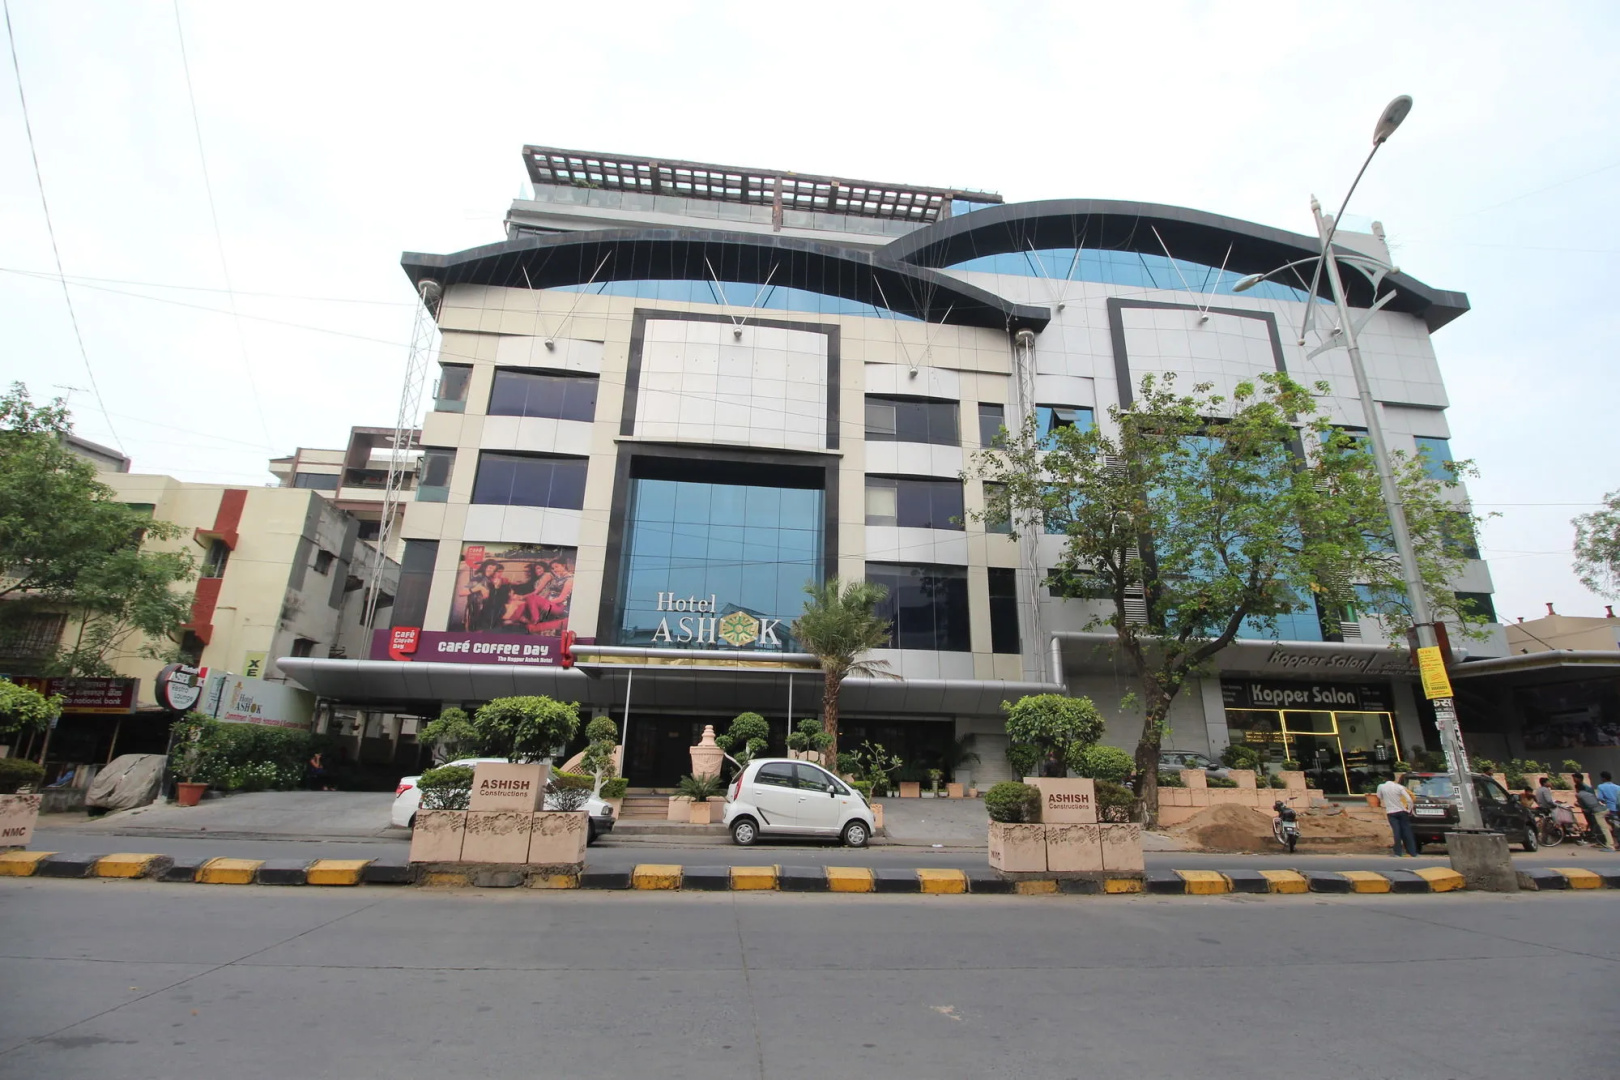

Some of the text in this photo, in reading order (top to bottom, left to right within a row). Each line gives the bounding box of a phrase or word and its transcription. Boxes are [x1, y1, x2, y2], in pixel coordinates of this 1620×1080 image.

[657, 592, 716, 613] Hotel
[651, 611, 782, 646] ASHOK
[1269, 651, 1325, 668] Kopper
[1327, 654, 1368, 669] Salon
[240, 694, 253, 703] Hotel
[1252, 684, 1308, 706] Kopper
[1312, 687, 1356, 704] Salon
[481, 779, 530, 790] ASHISH
[479, 789, 528, 798] Constructions
[1048, 794, 1089, 803] ASHISH
[2, 826, 26, 837] NMC
